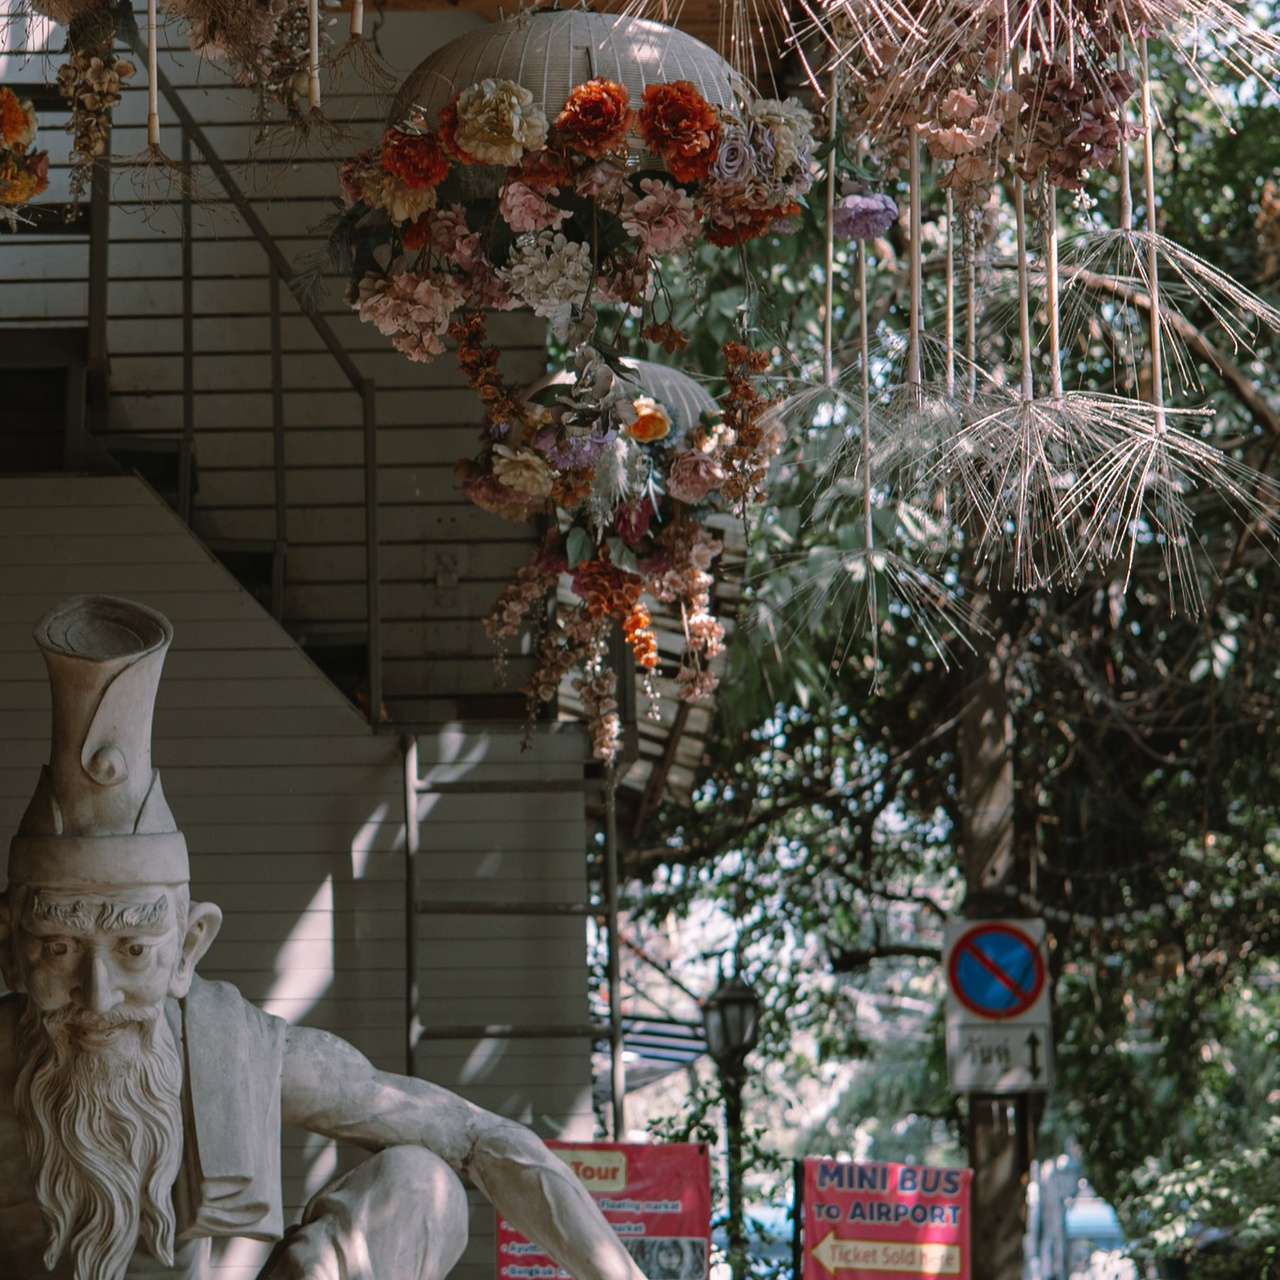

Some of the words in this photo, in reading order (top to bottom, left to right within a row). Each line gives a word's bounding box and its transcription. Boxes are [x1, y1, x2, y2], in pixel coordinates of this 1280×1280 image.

[817, 1163, 888, 1191] MINI
[899, 1167, 961, 1195] BUS
[814, 1203, 841, 1219] TO
[849, 1202, 962, 1224] AIRPORT
[830, 1244, 878, 1262] Ticket
[882, 1246, 916, 1266] Sold
